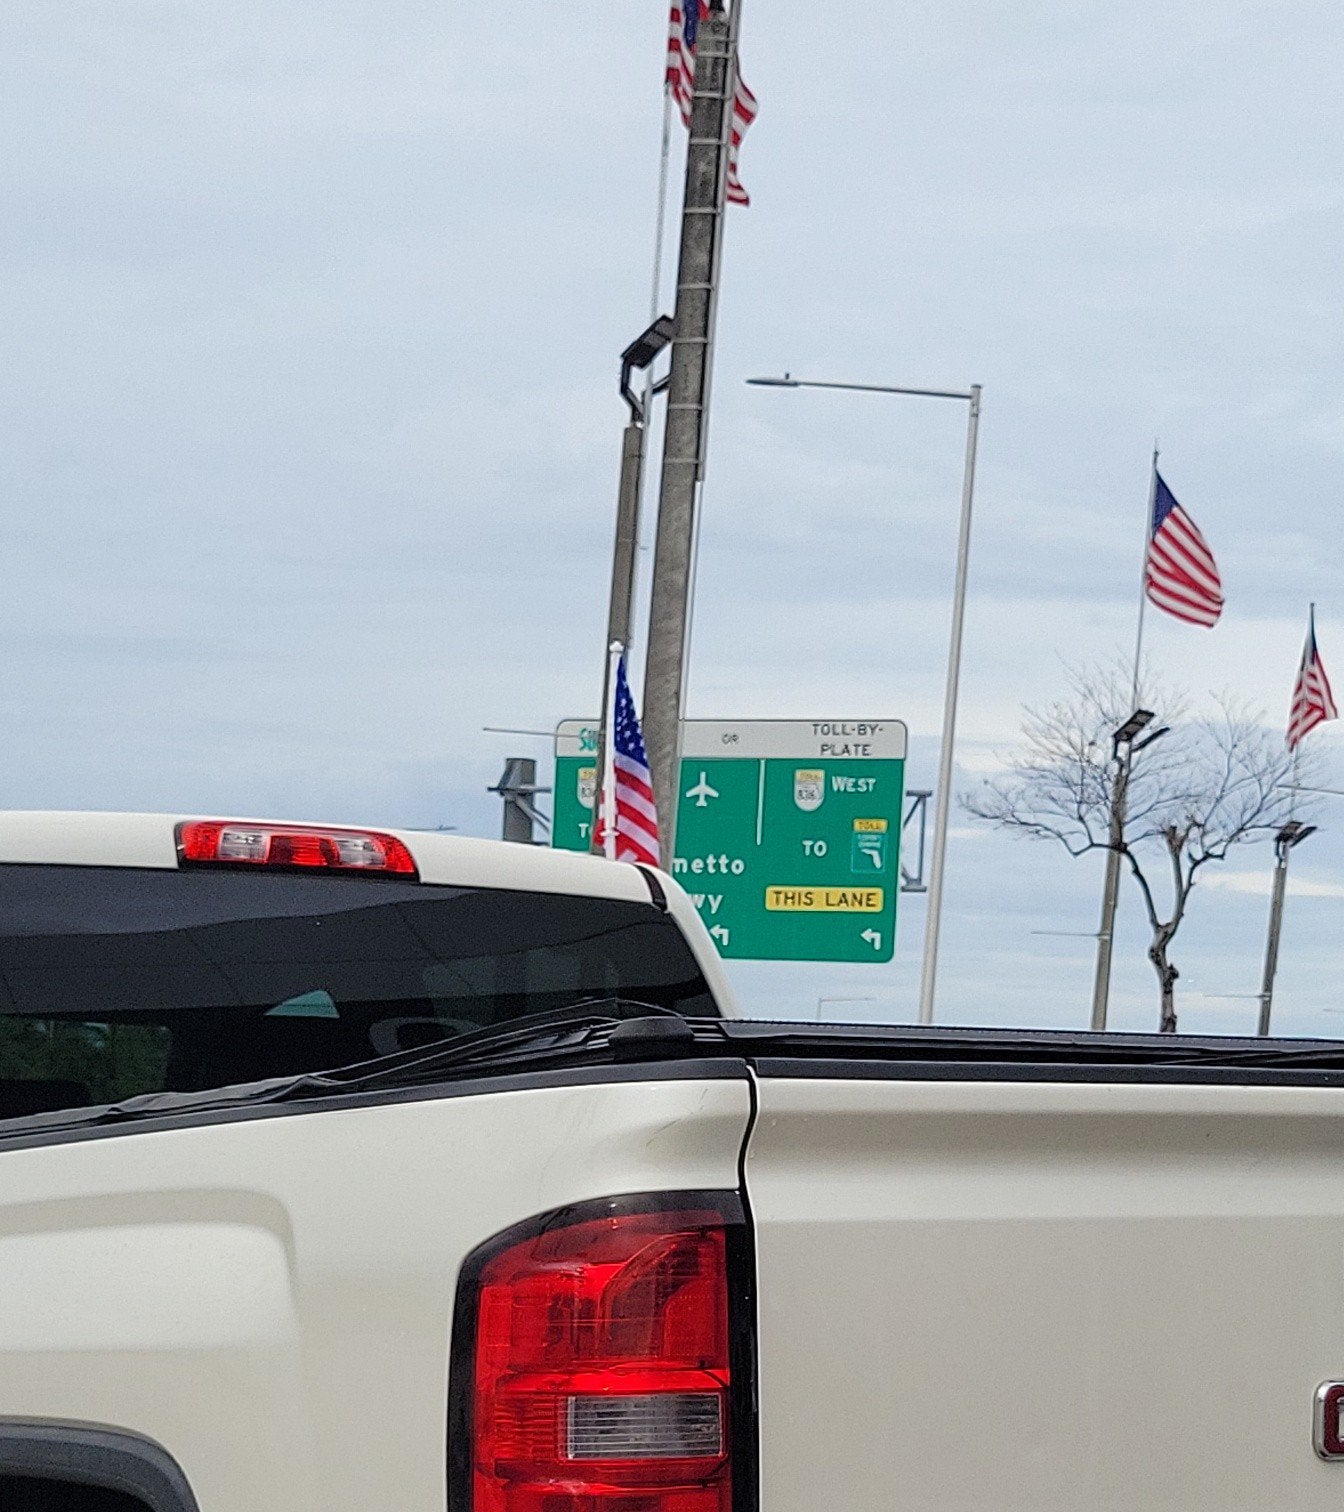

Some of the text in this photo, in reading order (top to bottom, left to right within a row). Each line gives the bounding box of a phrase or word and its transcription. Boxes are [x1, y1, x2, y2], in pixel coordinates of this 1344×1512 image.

[812, 723, 884, 737] TOLL-BY-
[820, 743, 872, 757] PLATE
[831, 775, 876, 793] WEST
[802, 839, 827, 857] TO
[772, 890, 878, 908] THIS LANE
